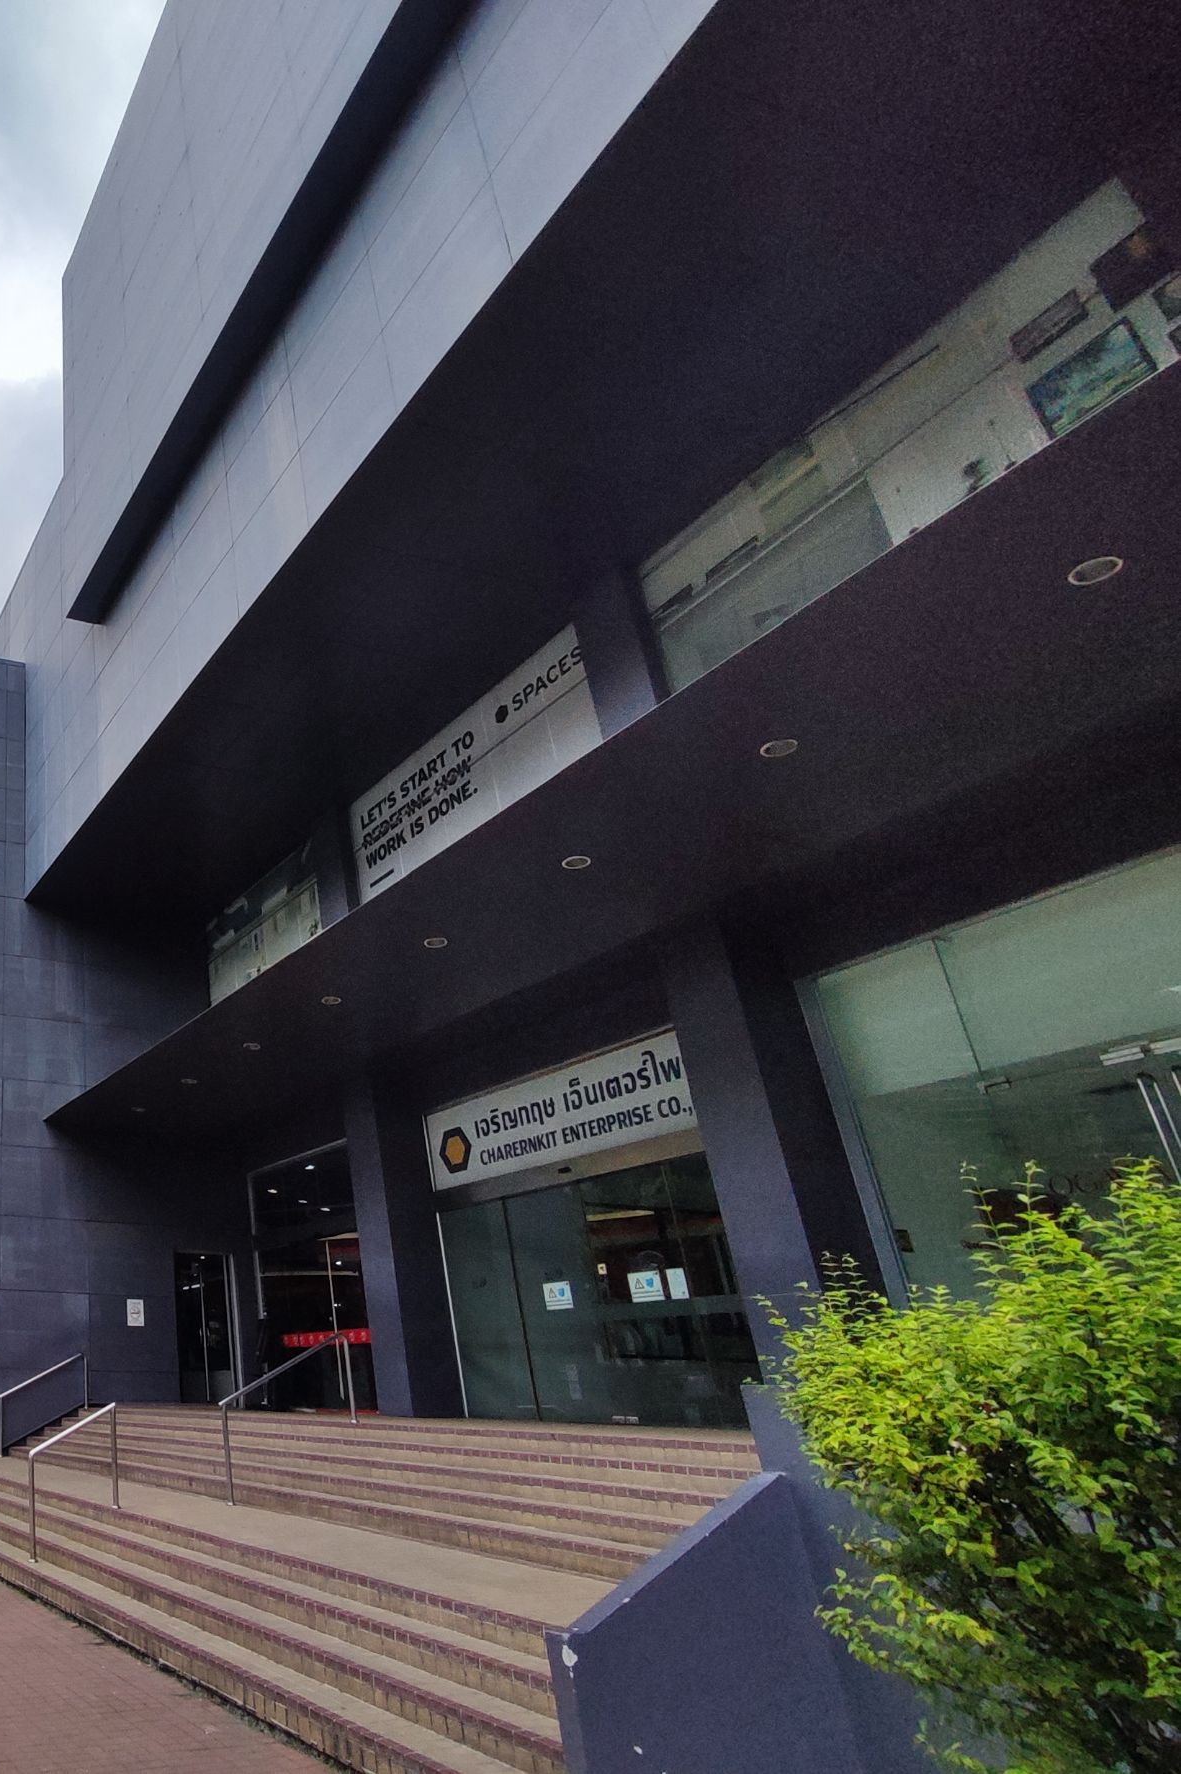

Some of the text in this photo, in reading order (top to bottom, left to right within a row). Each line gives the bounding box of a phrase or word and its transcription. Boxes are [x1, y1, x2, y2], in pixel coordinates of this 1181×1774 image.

[511, 645, 582, 712] SPACES
[360, 730, 475, 830] LET'S START TO
[434, 755, 472, 796] HOW
[365, 779, 479, 869] WORK IS DONE.
[479, 1130, 557, 1166] CHARERNKIT
[561, 1103, 655, 1145] ENTERPRISE
